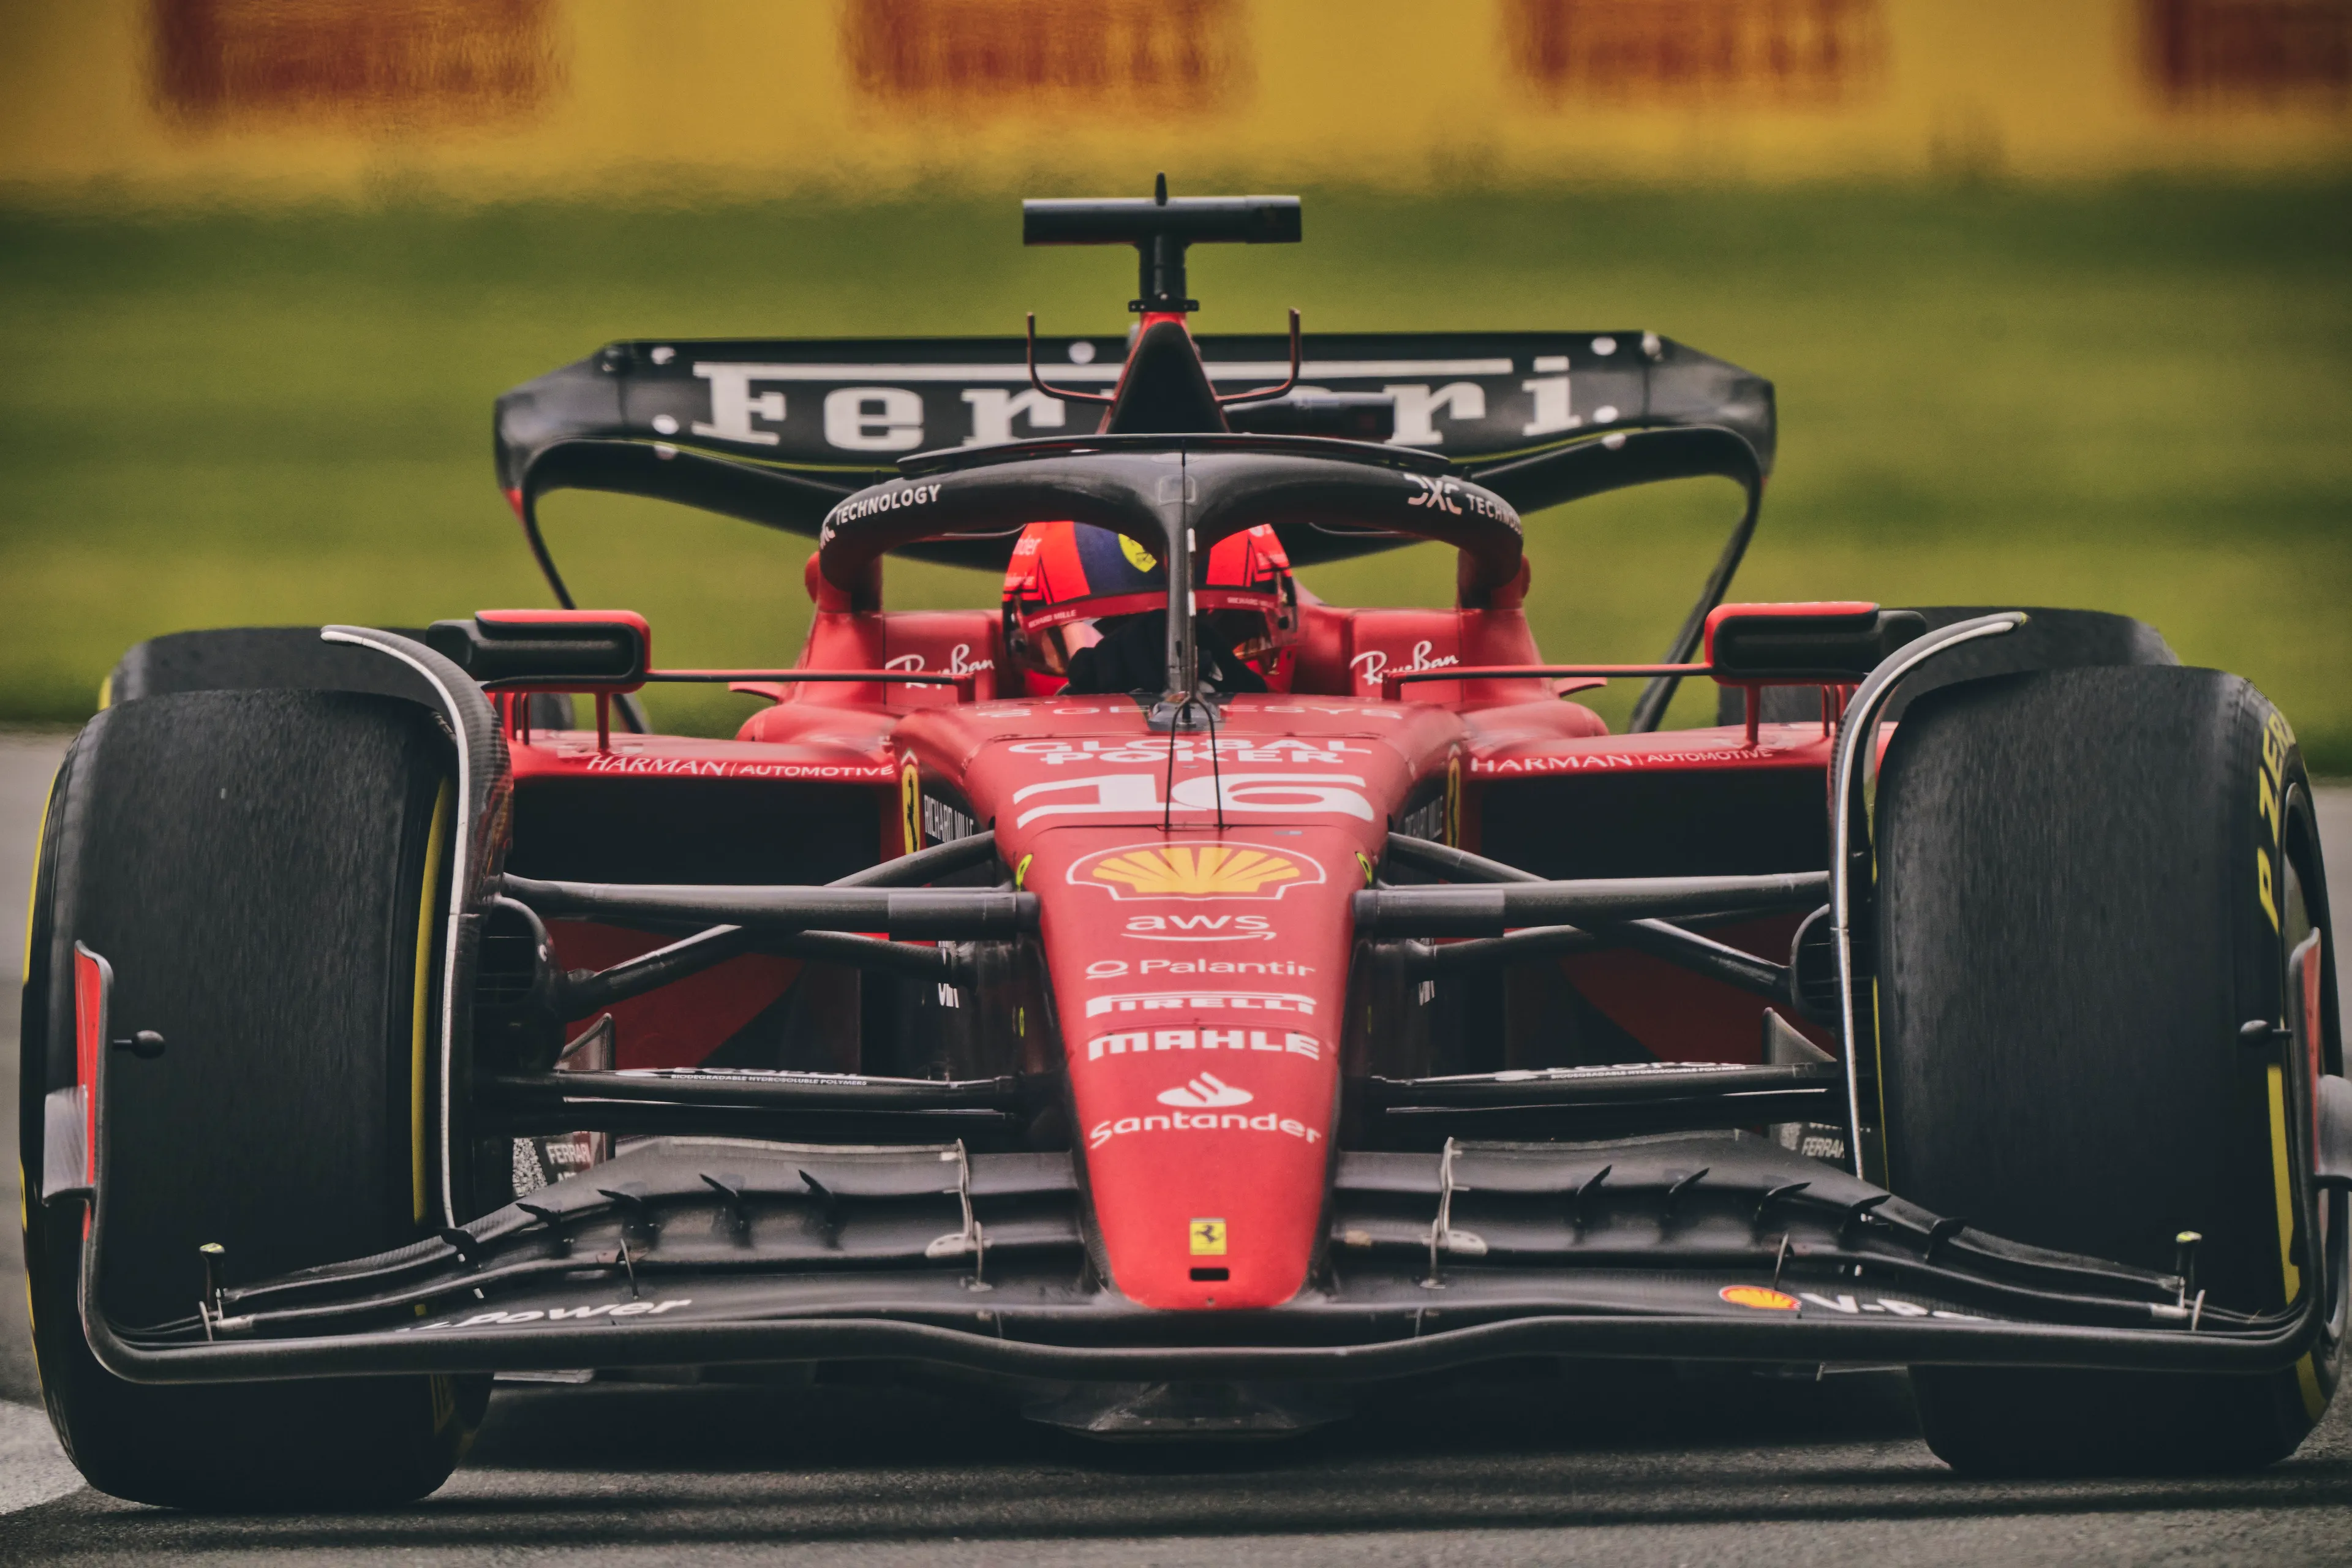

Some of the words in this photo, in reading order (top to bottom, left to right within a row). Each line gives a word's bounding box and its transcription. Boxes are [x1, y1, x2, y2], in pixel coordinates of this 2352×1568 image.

[835, 483, 942, 526] TECHNOLOGY
[1403, 473, 1463, 515] DXC
[1053, 609, 1077, 620] MILLE
[1053, 704, 1403, 720] GEESYS
[1008, 739, 1373, 755] GLOBAL
[1039, 750, 1344, 766] POKER
[586, 755, 728, 776] HARMAN
[739, 764, 895, 777] AUTOMOTIVE
[1471, 753, 1632, 772] HARMAN
[1647, 748, 1775, 763] AUTOMOTIVE
[1012, 773, 1374, 830] 16
[2258, 848, 2279, 937] P
[1125, 914, 1271, 931] aws
[1140, 957, 1316, 978] Palantir
[1085, 990, 1318, 1019] PIRELLI
[1088, 1029, 1321, 1062] MAHLE
[1088, 1111, 1323, 1150] Santander
